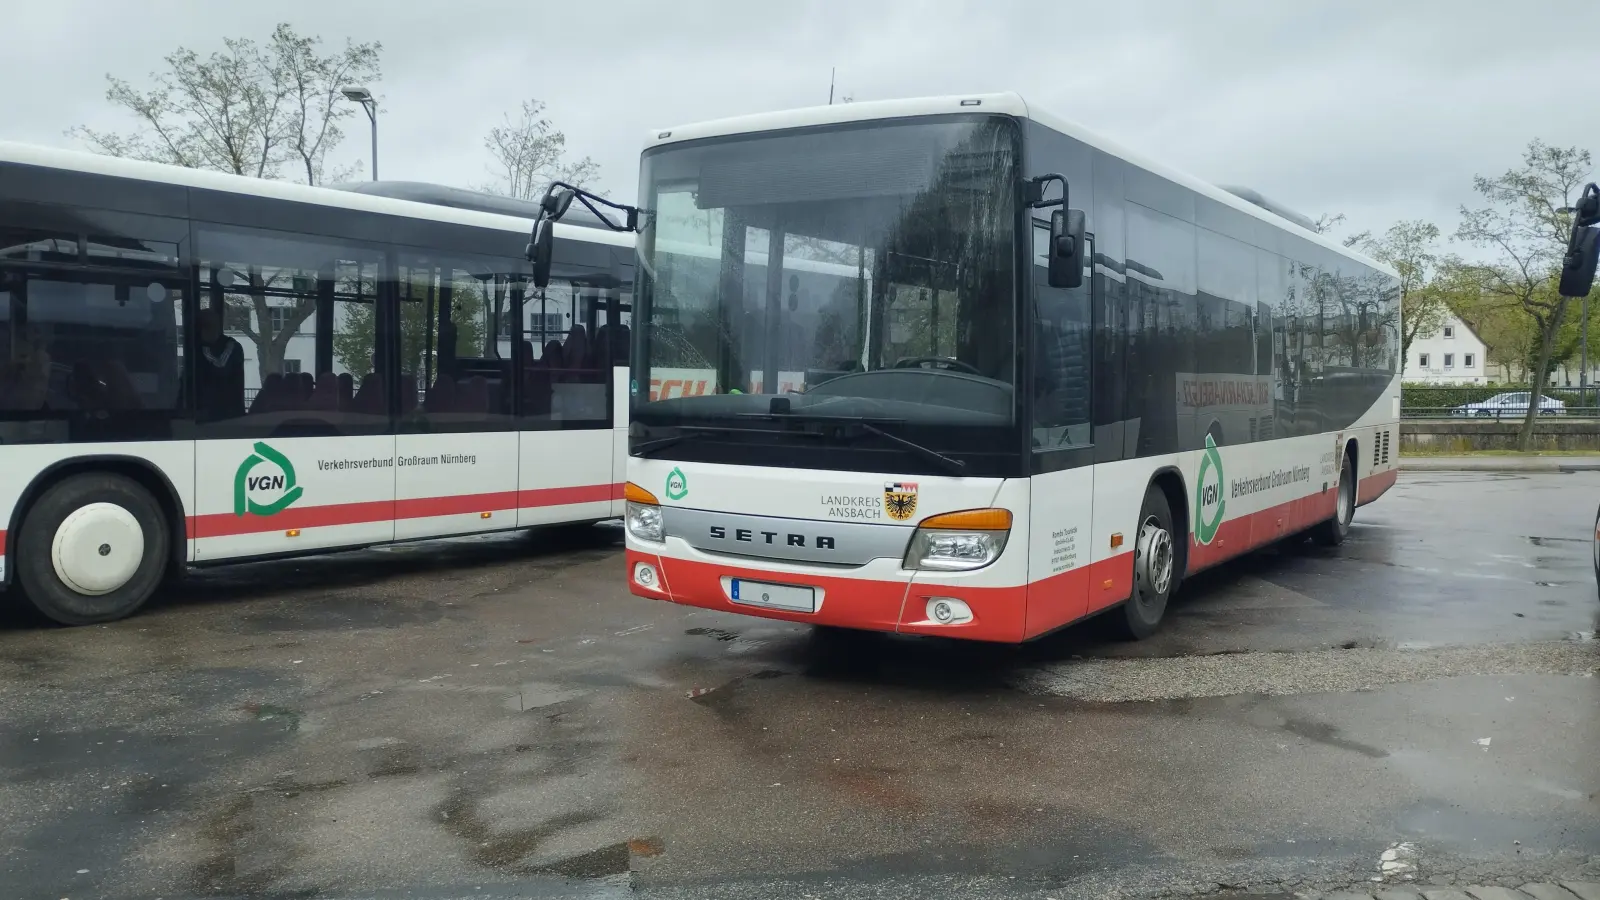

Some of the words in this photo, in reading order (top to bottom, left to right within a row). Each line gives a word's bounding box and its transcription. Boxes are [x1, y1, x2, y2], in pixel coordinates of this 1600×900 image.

[318, 457, 394, 470] Verkehrsverbund
[397, 454, 439, 466] Großraum
[441, 453, 476, 465] Nürnberg
[247, 476, 284, 491] VGN
[670, 481, 682, 489] VGN
[1231, 472, 1271, 498] Verkehrsverbund
[821, 496, 881, 507] LANDKREIS
[1202, 483, 1218, 506] VGN
[828, 508, 881, 519] ANSBACH
[710, 526, 835, 549] SETRA
